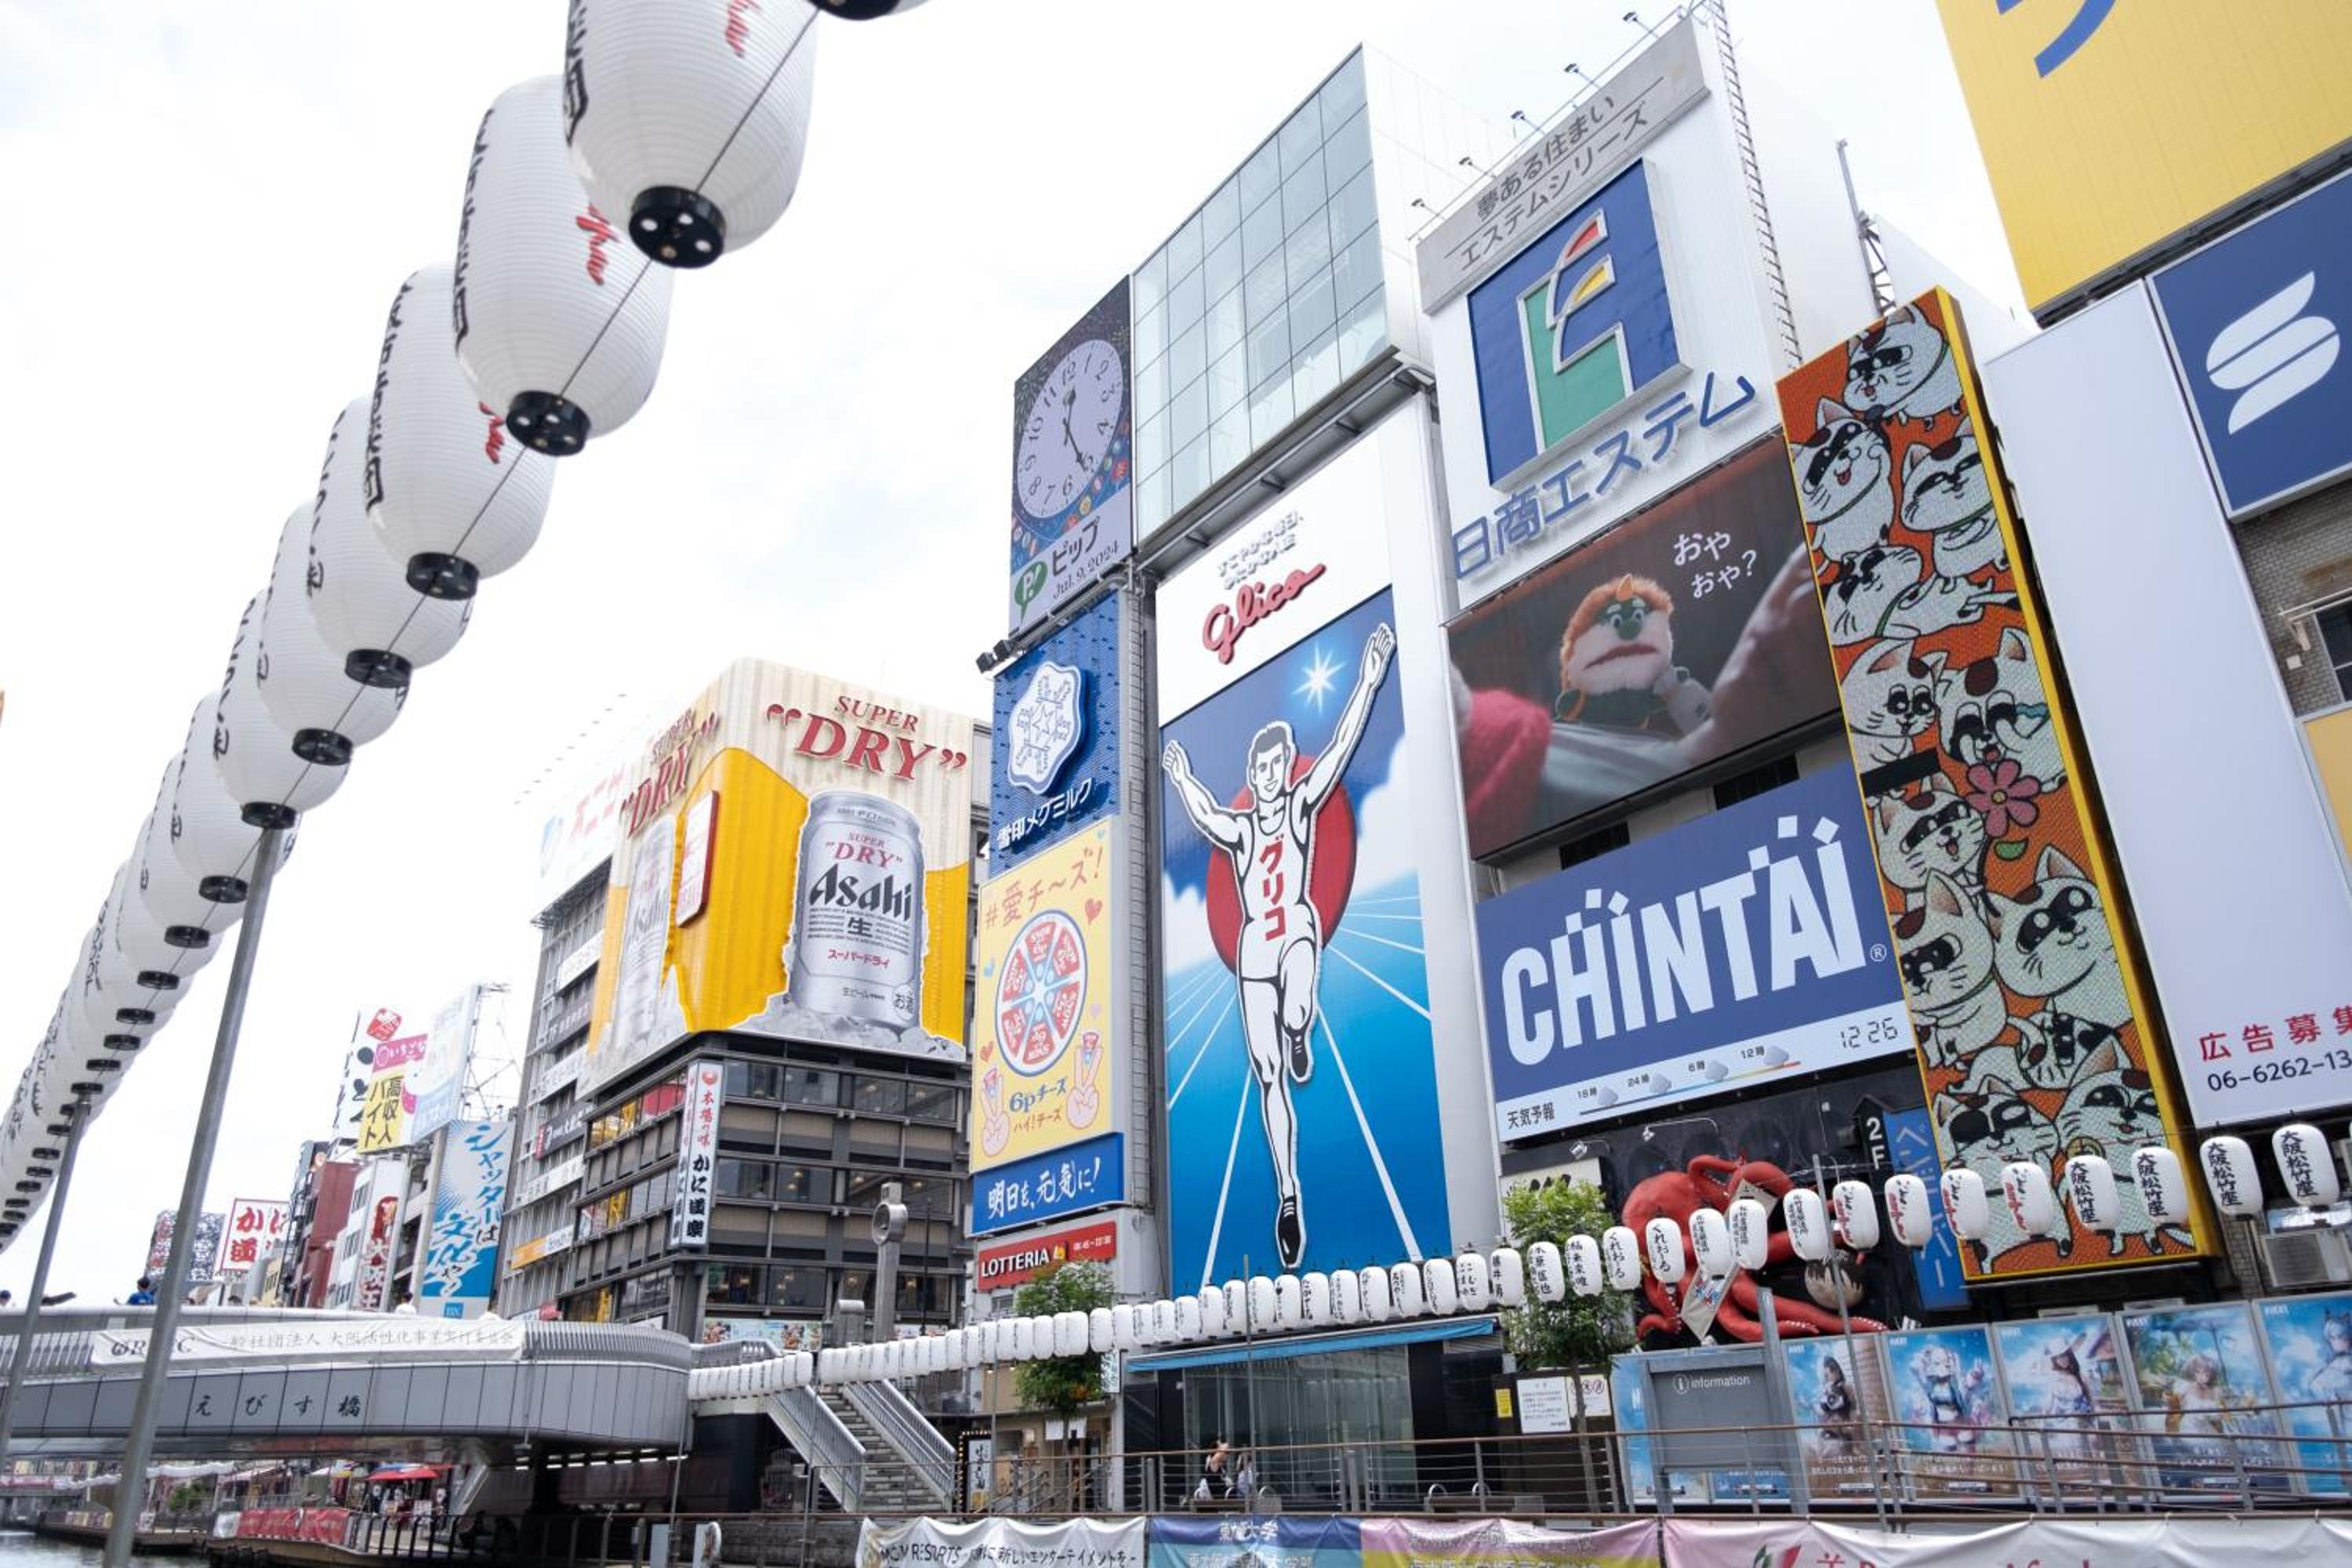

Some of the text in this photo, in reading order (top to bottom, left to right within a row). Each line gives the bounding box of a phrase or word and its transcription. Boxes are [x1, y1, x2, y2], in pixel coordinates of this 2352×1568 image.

[1461, 100, 1647, 270] エステムシリーズ
[1477, 96, 1614, 221] 夢ある住まい
[1451, 371, 1755, 579] 日商エステム
[1054, 516, 1100, 576] ピップ
[1088, 540, 1118, 572] 2024
[1673, 531, 1730, 566] おや
[1692, 550, 1757, 598] おや?
[1203, 563, 1327, 665] Glico
[836, 695, 919, 732] SUPER
[849, 832, 884, 848] SUPER
[997, 778, 1092, 849] 雪印メグミルク
[809, 862, 912, 922] Asahi
[1259, 833, 1286, 942] グリコ
[848, 917, 873, 938] 生
[1501, 815, 1867, 1065] CHINTAI
[828, 948, 890, 968] スーパードライ
[1741, 1046, 1765, 1059] 12時
[2207, 1050, 2352, 1092] 06-6262-13
[365, 1078, 387, 1148] バイト
[1507, 1102, 1556, 1130] 天気予報
[465, 1123, 508, 1245] シャッターは
[2137, 1153, 2169, 1217] 大阪松竹座
[2208, 1142, 2242, 1207] 大阪松竹座
[2281, 1131, 2318, 1197] 大阪松竹座
[2071, 1163, 2100, 1224] 大阪松竹座
[982, 1247, 1049, 1278] LOTTERIA
[1610, 1232, 1626, 1279] くれおーる
[1652, 1223, 1671, 1272] くれおーる
[196, 1392, 361, 1417] えびす橋
[1691, 1374, 1751, 1390] information
